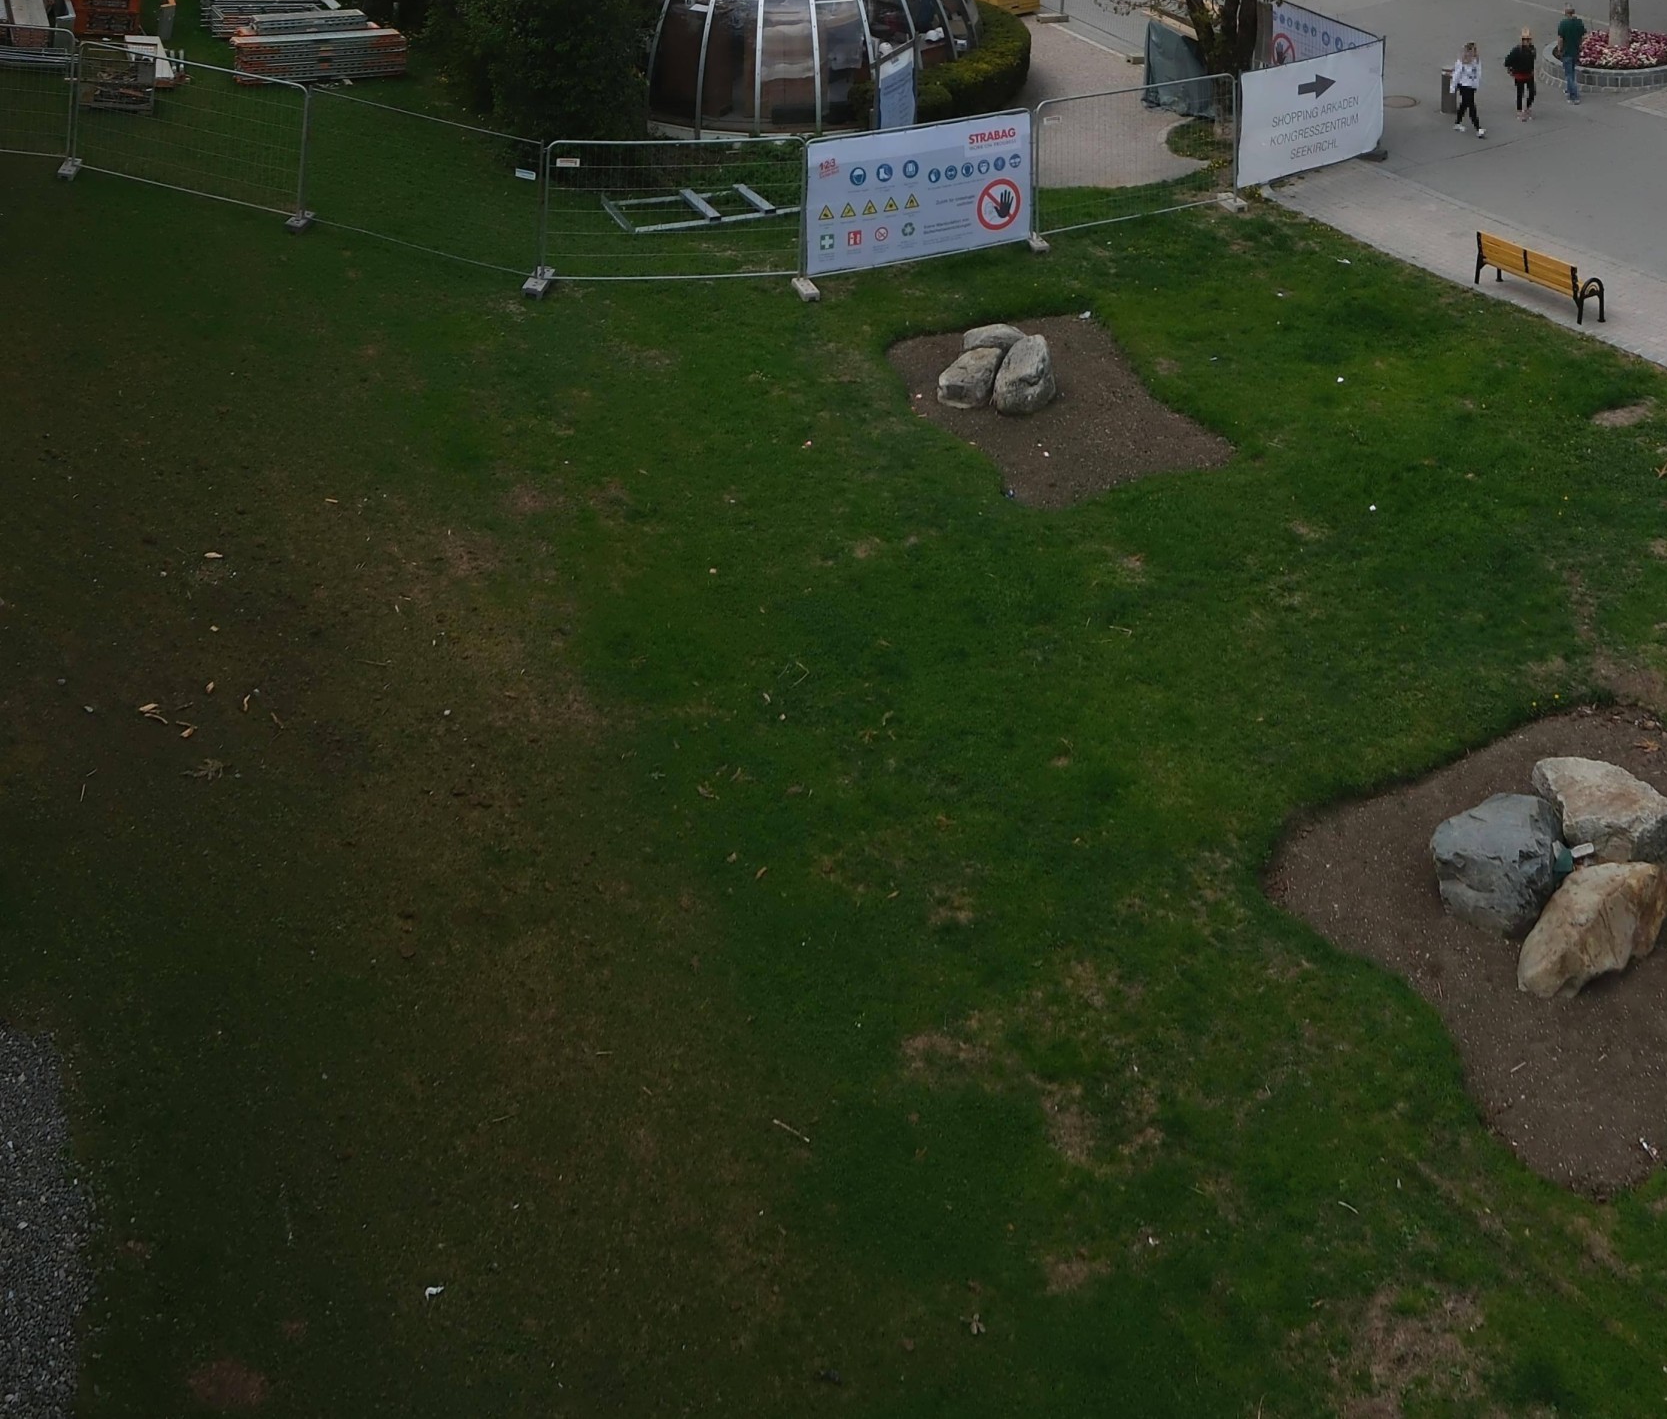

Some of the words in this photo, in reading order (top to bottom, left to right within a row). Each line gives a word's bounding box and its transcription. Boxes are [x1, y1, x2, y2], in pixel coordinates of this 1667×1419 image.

[1272, 106, 1319, 128] SHOPPING
[1320, 95, 1360, 116] ARKADEN
[968, 127, 1016, 145] STRABAG
[1270, 113, 1360, 147] KONGRESSZENTRUM
[1290, 138, 1339, 160] SEEKIRCHL
